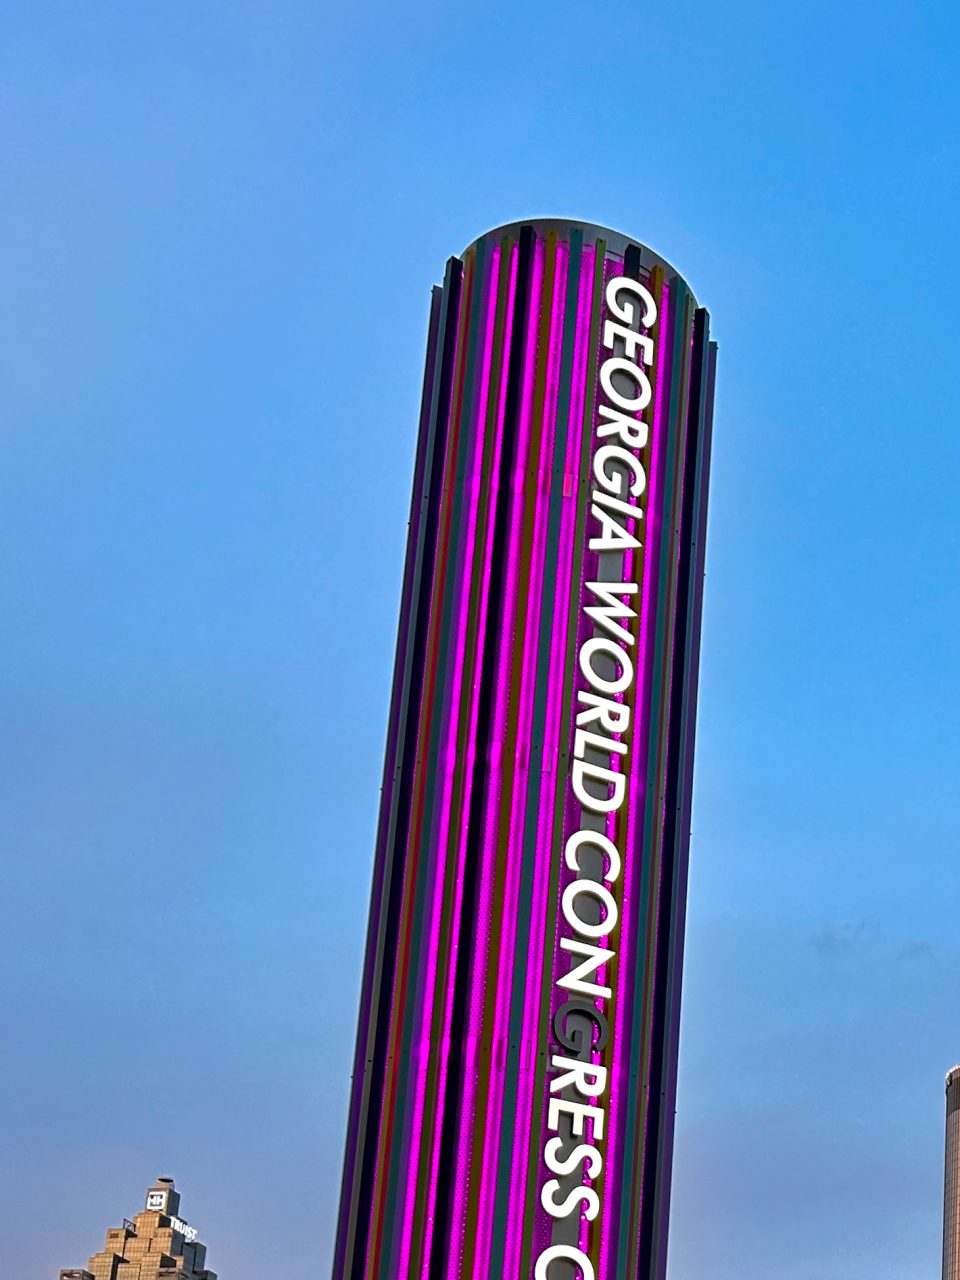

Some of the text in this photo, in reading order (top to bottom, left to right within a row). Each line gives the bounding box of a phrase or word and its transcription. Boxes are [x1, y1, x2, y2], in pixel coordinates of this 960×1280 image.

[588, 276, 657, 551] GEORGIA
[572, 582, 638, 813] WORLD
[540, 827, 620, 1222] CONGRESS
[170, 1216, 197, 1241] TRUIST
